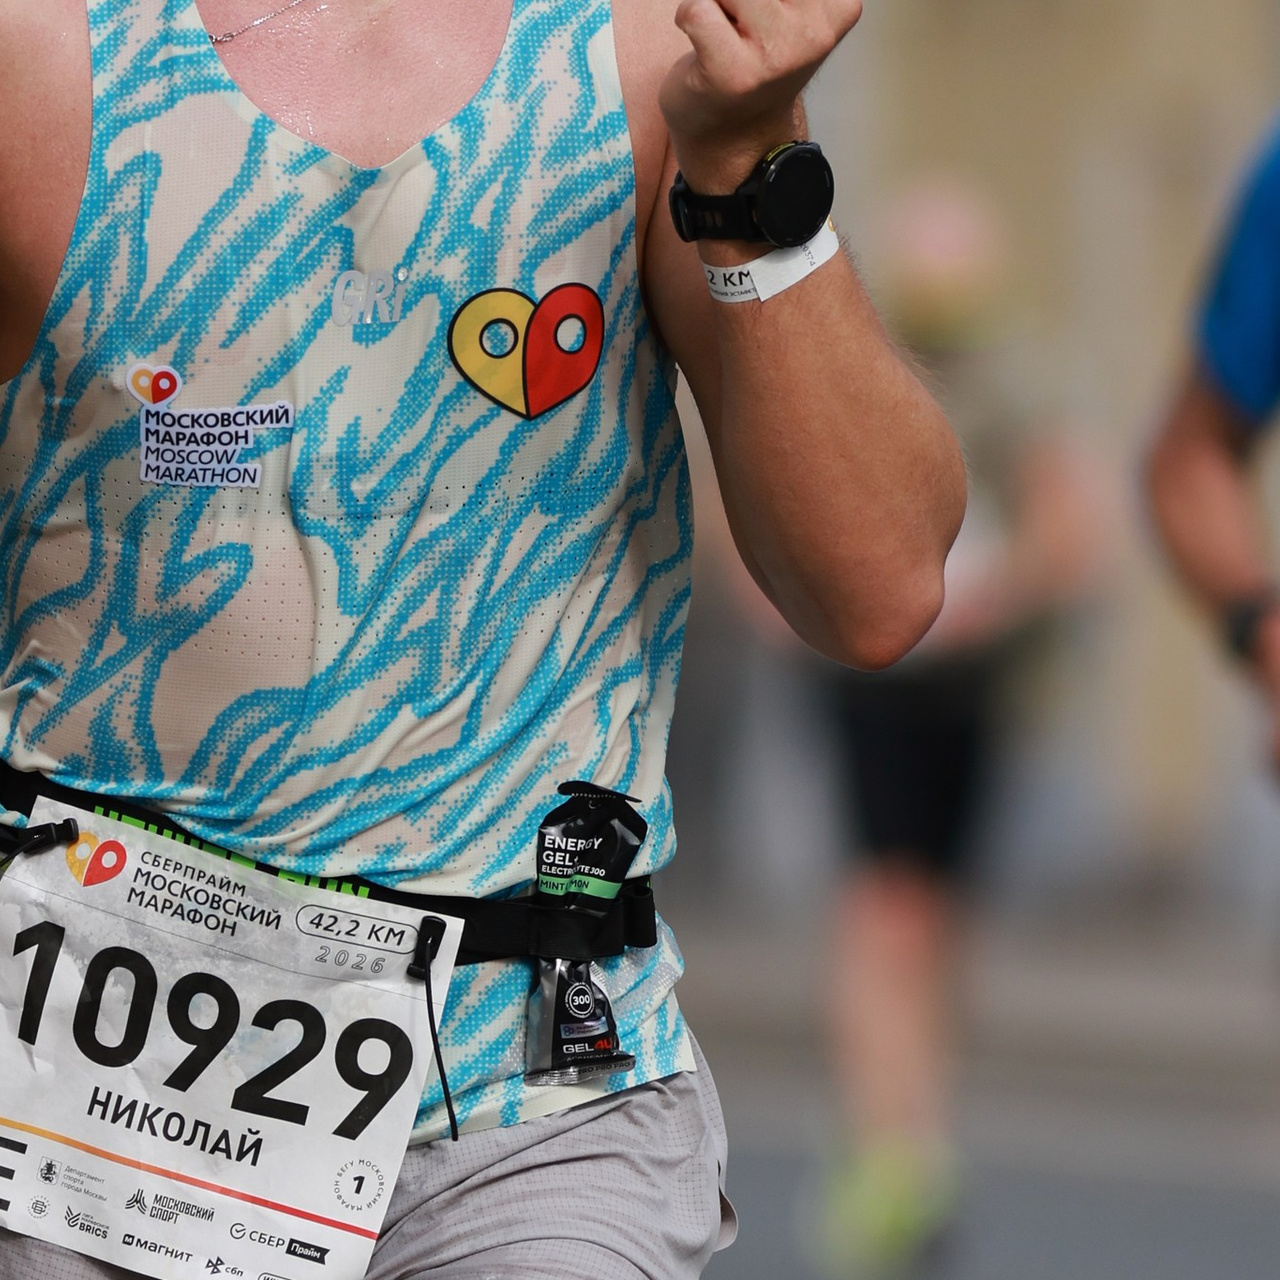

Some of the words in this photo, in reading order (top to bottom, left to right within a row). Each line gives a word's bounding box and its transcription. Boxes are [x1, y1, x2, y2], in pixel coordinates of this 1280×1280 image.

[145, 405, 289, 428] МОСКОВСКИЙ
[145, 428, 249, 446] МАРАФОН
[145, 447, 236, 465] MOSCOW
[145, 464, 257, 484] MARATHON
[544, 835, 603, 851] ENERGY
[141, 851, 246, 897] СБЕРПРАЙМ
[540, 879, 565, 891] MINT
[133, 867, 281, 930] МОСКОВСКИЙ
[127, 887, 237, 936] МАРАФОН
[309, 913, 360, 937] 42,2
[367, 924, 406, 946] КМ
[315, 945, 385, 973] 2026
[572, 995, 590, 1005] 300
[12, 920, 414, 1141] 10929
[86, 1086, 264, 1166] НИКОЛАЙ
[65, 1165, 105, 1184] Департамент
[337, 1160, 353, 1177] БЕГУ
[63, 1173, 84, 1186] спорта
[353, 1176, 365, 1195] 1
[358, 1159, 384, 1209] МОСКОВСКИЙ
[333, 1180, 362, 1210] МАРАФОН
[149, 1206, 180, 1224] СПОРТ
[153, 1194, 215, 1222] МОСКОВСКИЙ
[79, 1222, 108, 1239] BRICS
[249, 1230, 285, 1248] СБЕР
[290, 1242, 321, 1259] Прайм
[225, 1266, 244, 1277] сбп
